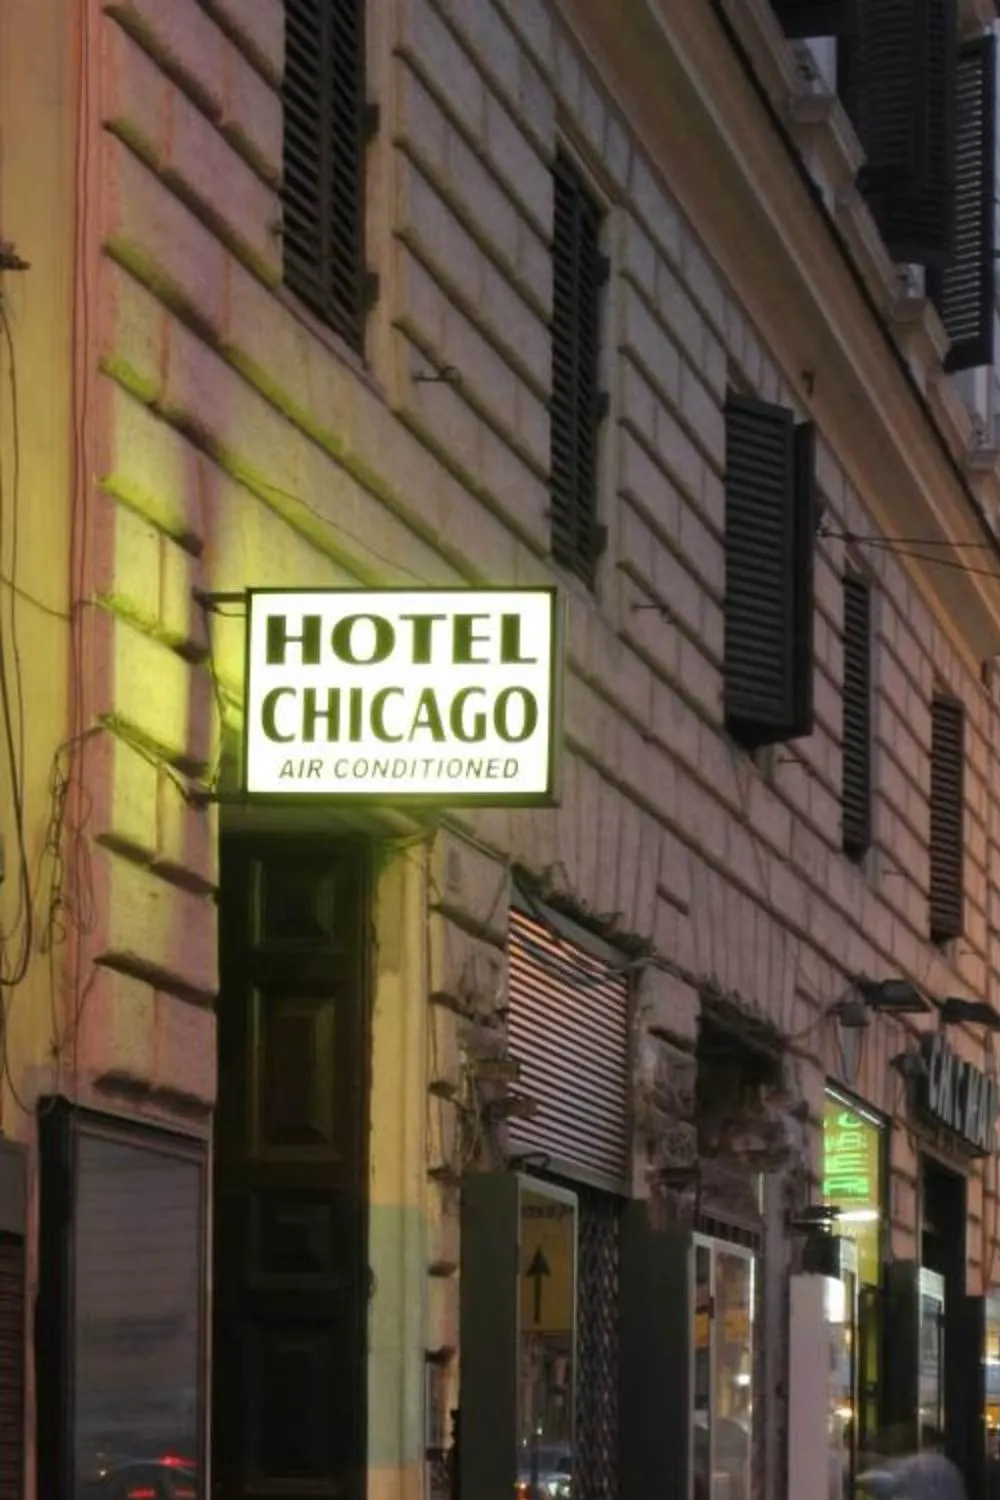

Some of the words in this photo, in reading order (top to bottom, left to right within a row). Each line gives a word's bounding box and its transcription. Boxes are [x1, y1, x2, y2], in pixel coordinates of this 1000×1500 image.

[266, 613, 538, 666] HOTEL
[260, 685, 539, 744] CHICAGO
[278, 757, 324, 779] AIR
[333, 756, 520, 780] CONDITIONED
